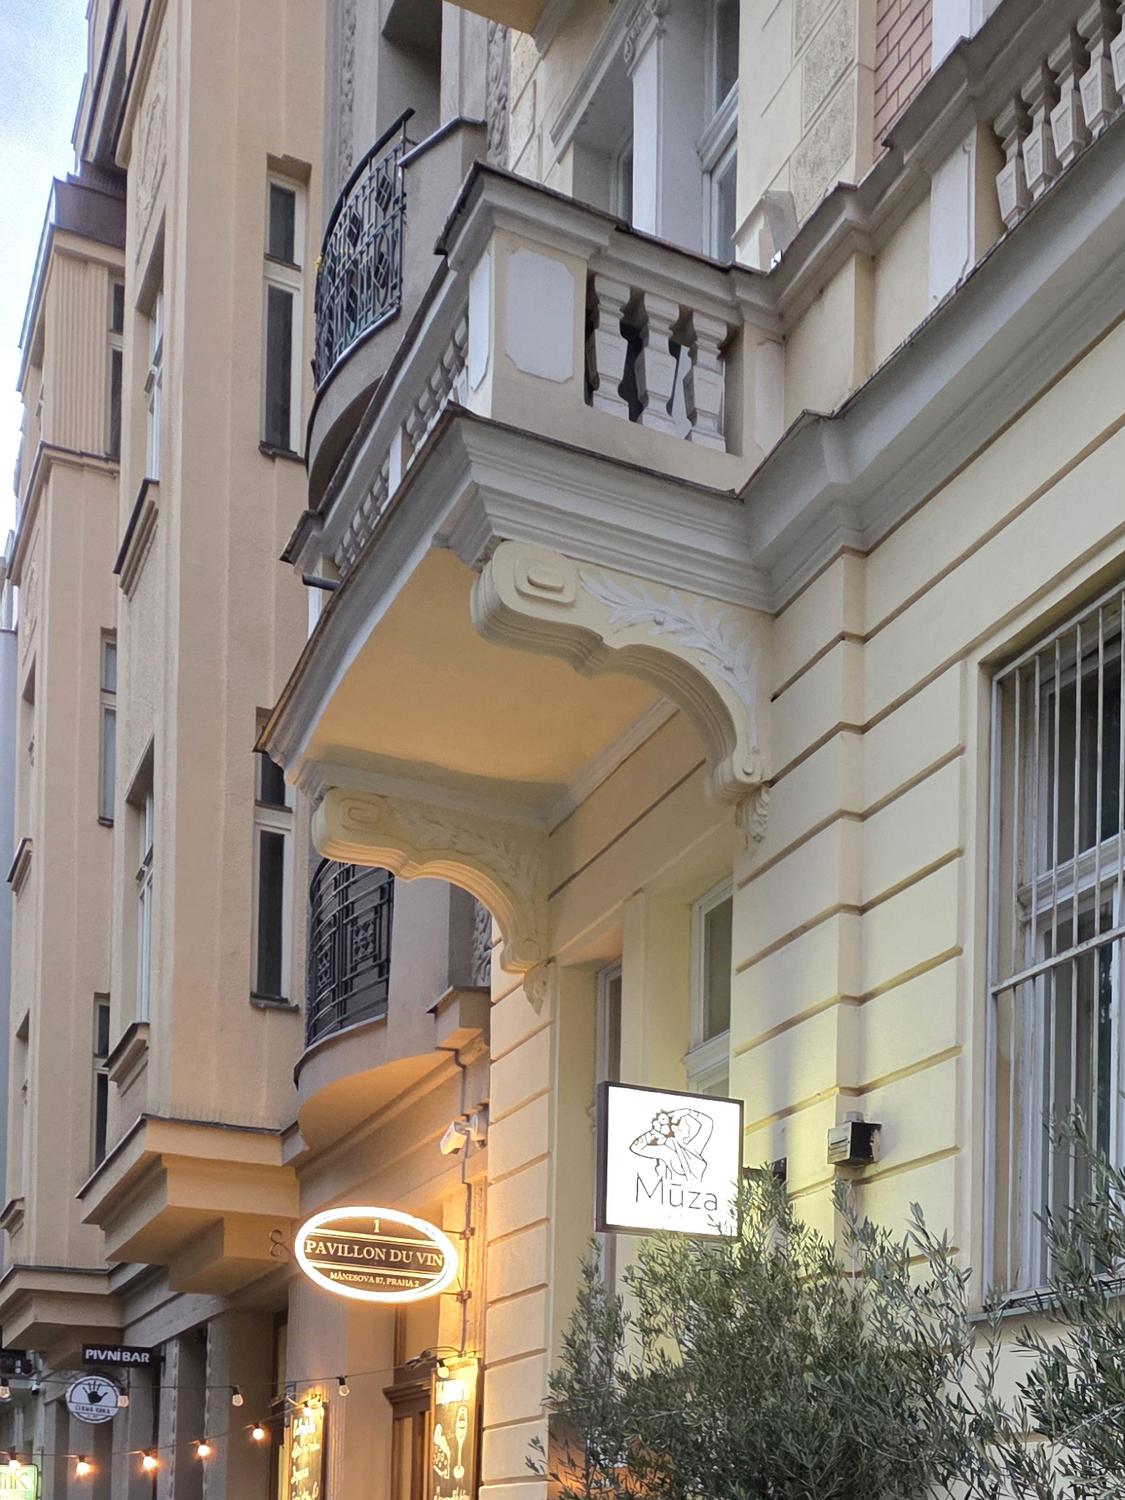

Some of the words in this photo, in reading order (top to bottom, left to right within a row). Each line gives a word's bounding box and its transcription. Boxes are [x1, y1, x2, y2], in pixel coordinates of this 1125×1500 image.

[635, 1172, 718, 1211] Mūza
[304, 1239, 386, 1261] PAVILLON
[389, 1249, 414, 1264] DU
[416, 1252, 444, 1267] VIN
[386, 1277, 414, 1288] PRAHA
[122, 1351, 150, 1363] BAR
